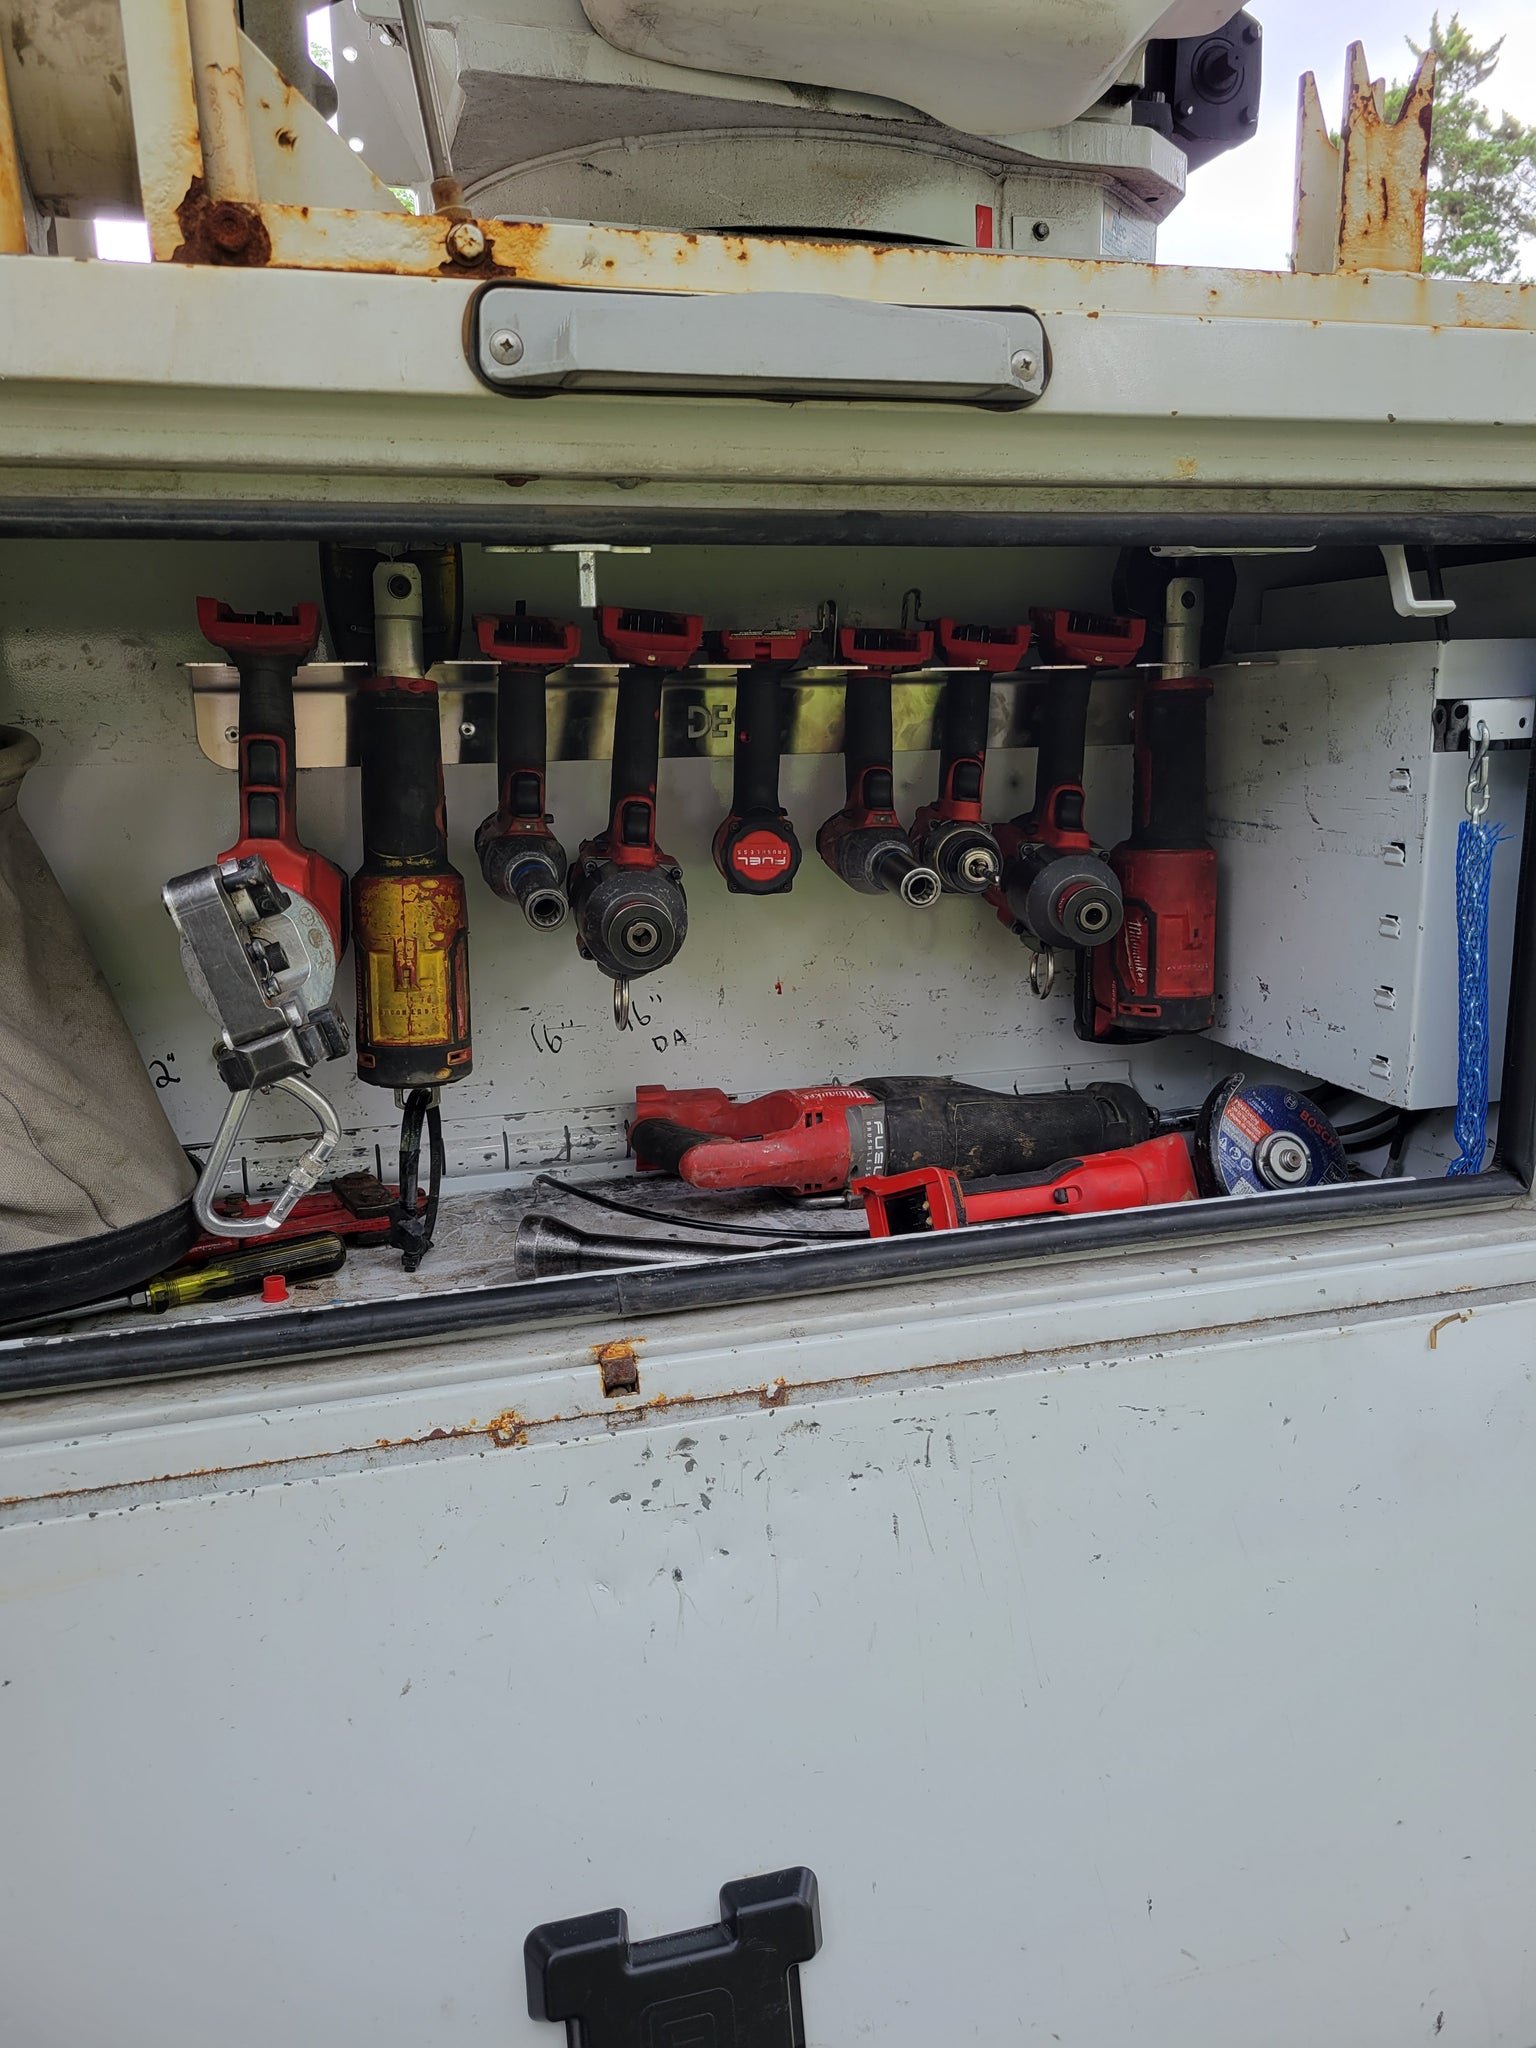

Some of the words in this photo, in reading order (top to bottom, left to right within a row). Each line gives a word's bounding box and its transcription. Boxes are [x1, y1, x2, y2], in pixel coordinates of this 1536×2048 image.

[688, 704, 736, 739] DE
[737, 856, 786, 866] FUEL
[1300, 1110, 1336, 1147] BOSCH
[865, 1121, 873, 1177] BRUSHLESS
[873, 1121, 884, 1175] FUEL
